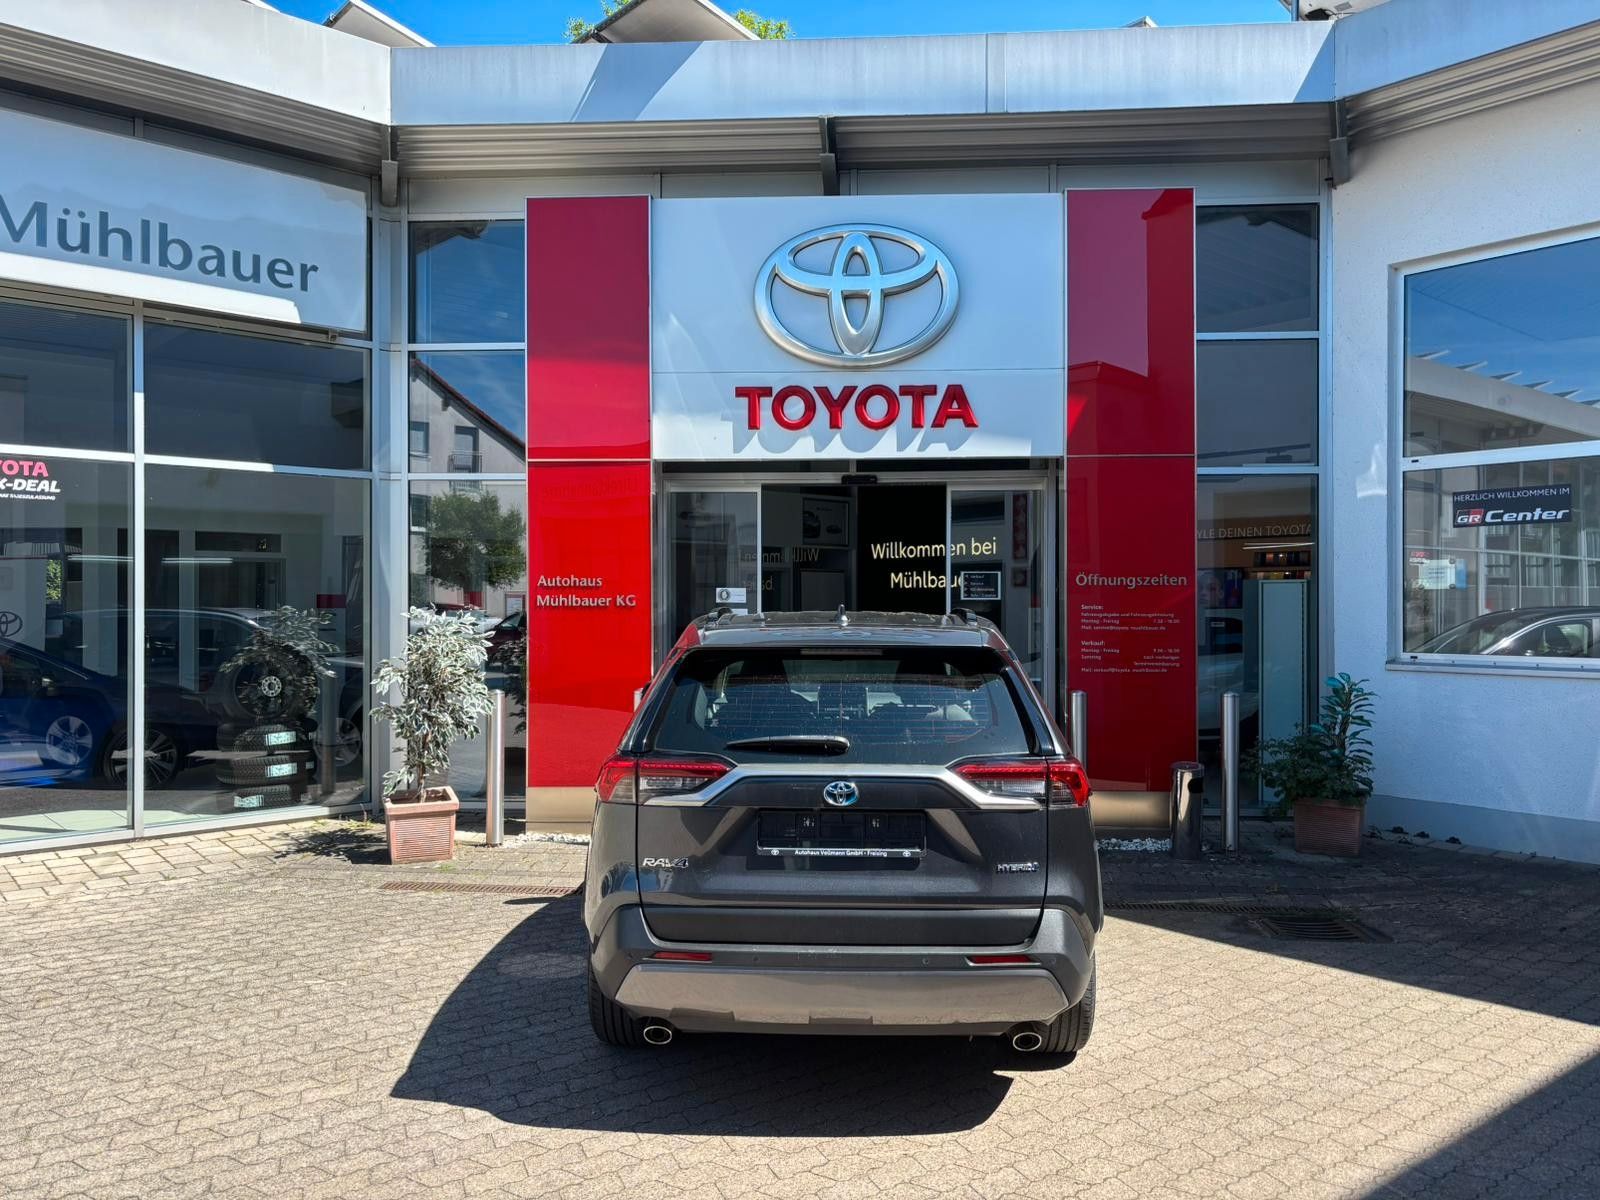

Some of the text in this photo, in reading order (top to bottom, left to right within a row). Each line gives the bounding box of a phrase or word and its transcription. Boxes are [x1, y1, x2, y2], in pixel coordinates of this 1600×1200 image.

[0, 194, 319, 292] Mühlbauer
[735, 383, 979, 431] TOYOTA
[0, 459, 49, 477] OTA
[1454, 487, 1570, 502] HERZLICH WILLKOMMEN IM
[1457, 508, 1569, 523] GR Center
[1219, 526, 1263, 538] DEINEN
[871, 537, 996, 559] Willkommen bei
[537, 574, 602, 587] Autohaus
[890, 570, 963, 589] Mühlbau
[1076, 572, 1188, 589] Öffnungszeiten
[536, 594, 637, 607] Mühlbauer KG
[642, 857, 689, 869] RAV4
